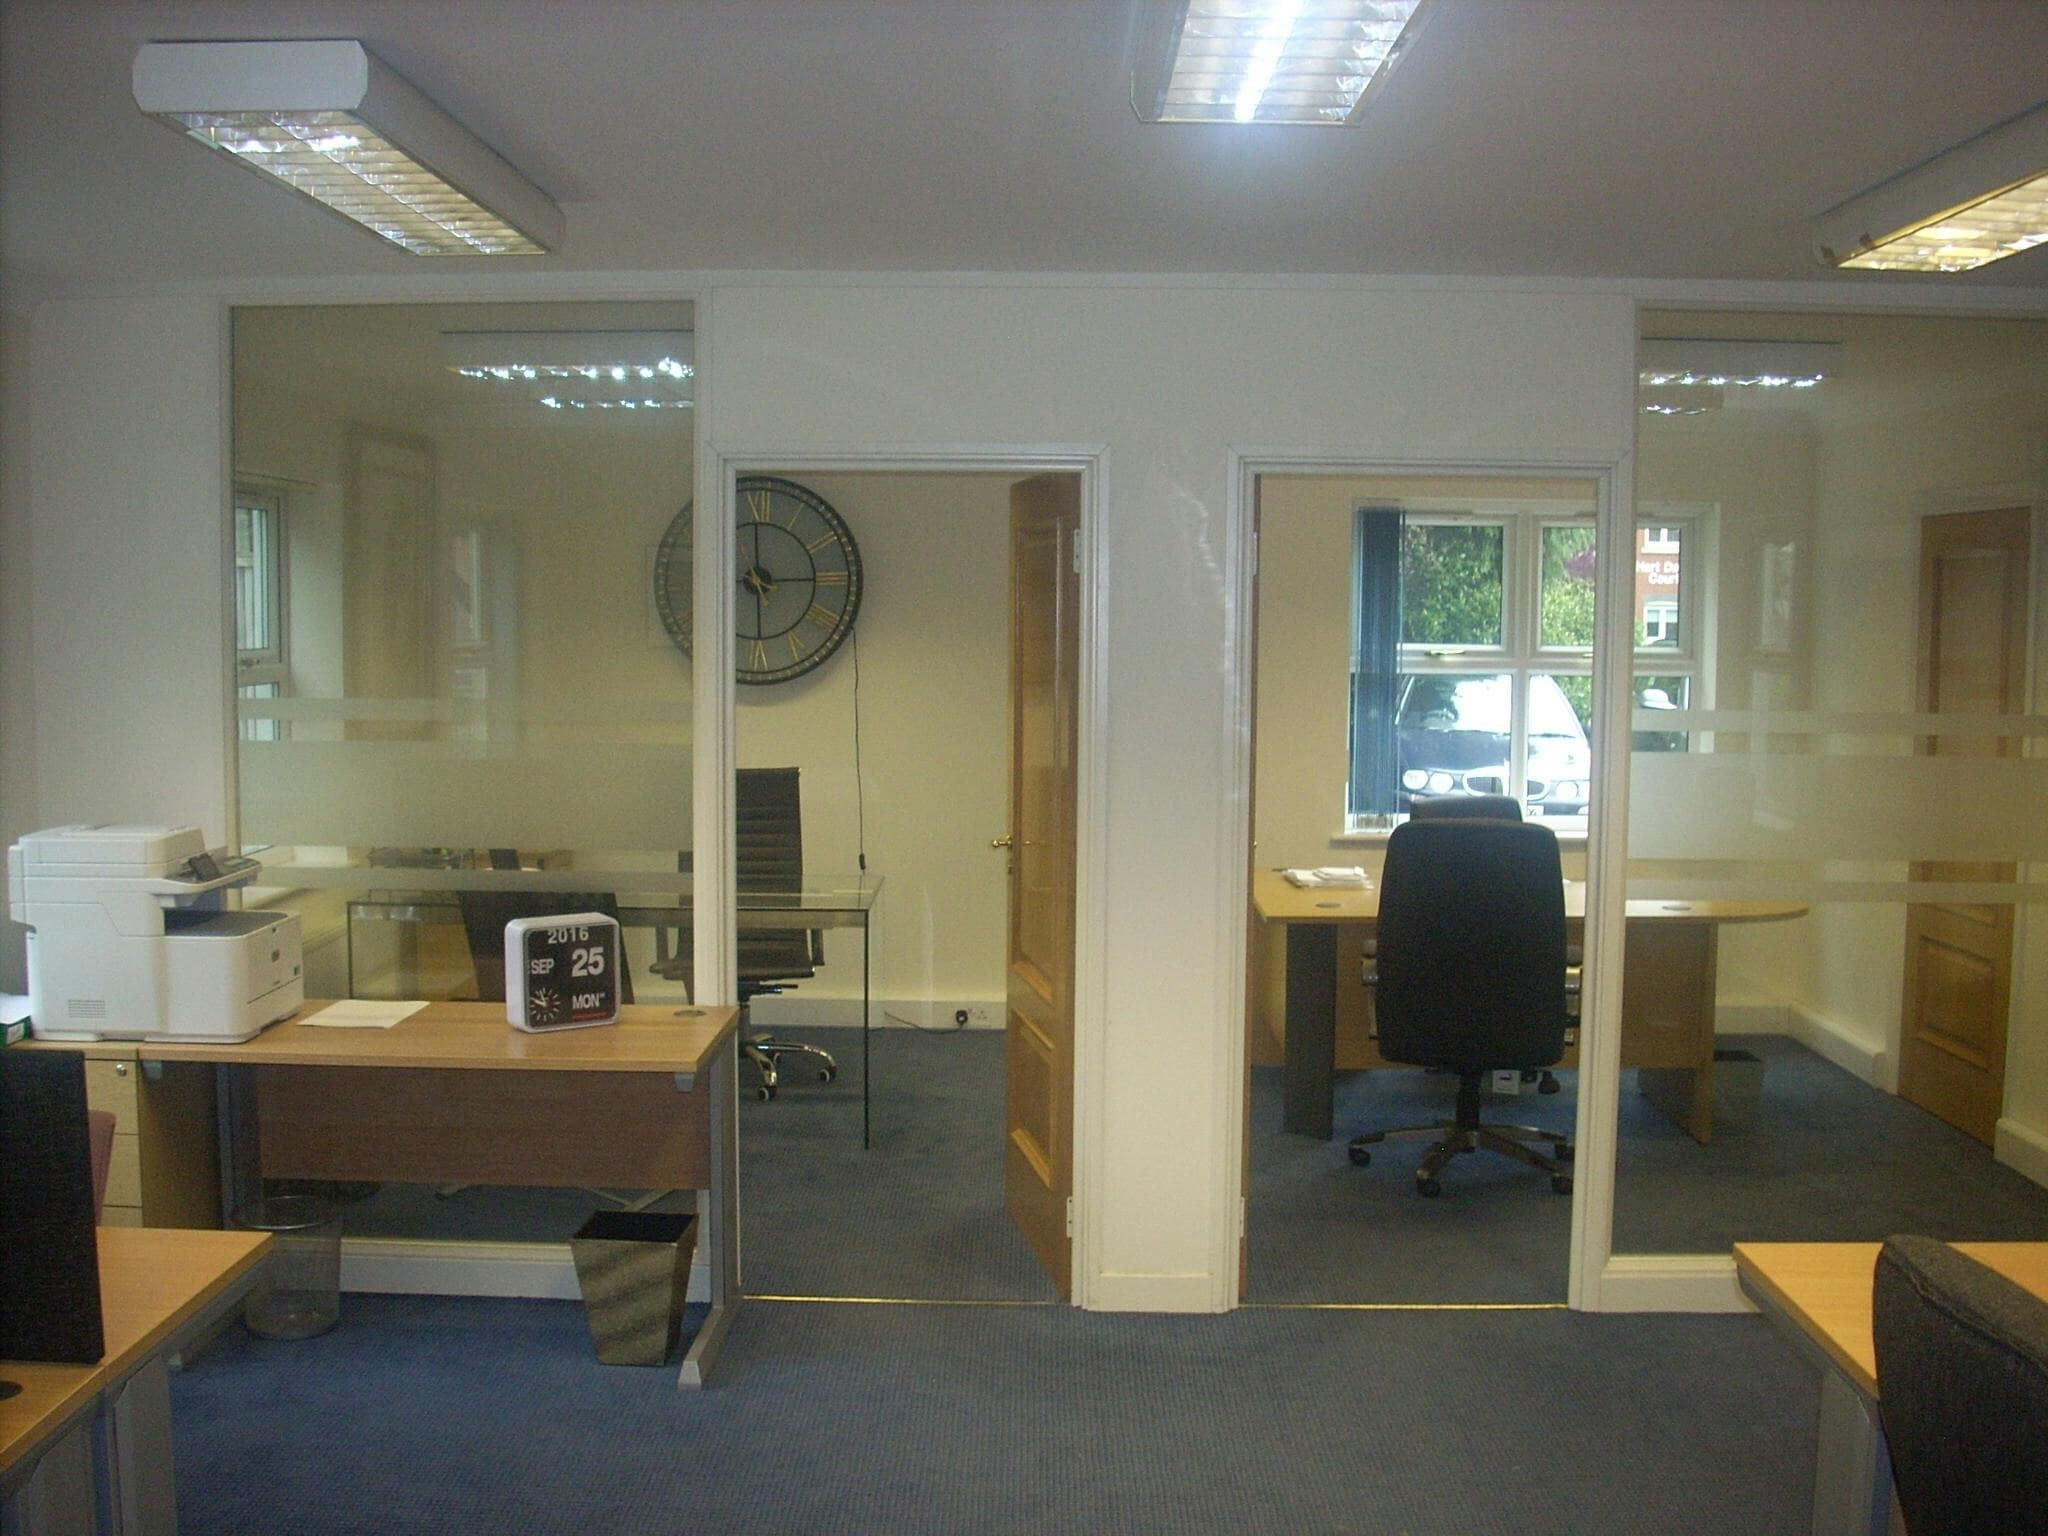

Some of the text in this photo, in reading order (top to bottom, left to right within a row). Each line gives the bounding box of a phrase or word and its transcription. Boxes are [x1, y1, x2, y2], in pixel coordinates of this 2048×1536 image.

[547, 926, 590, 944] 2016
[530, 958, 555, 975] SEP
[571, 946, 606, 978] 25
[571, 992, 601, 1010] MON
